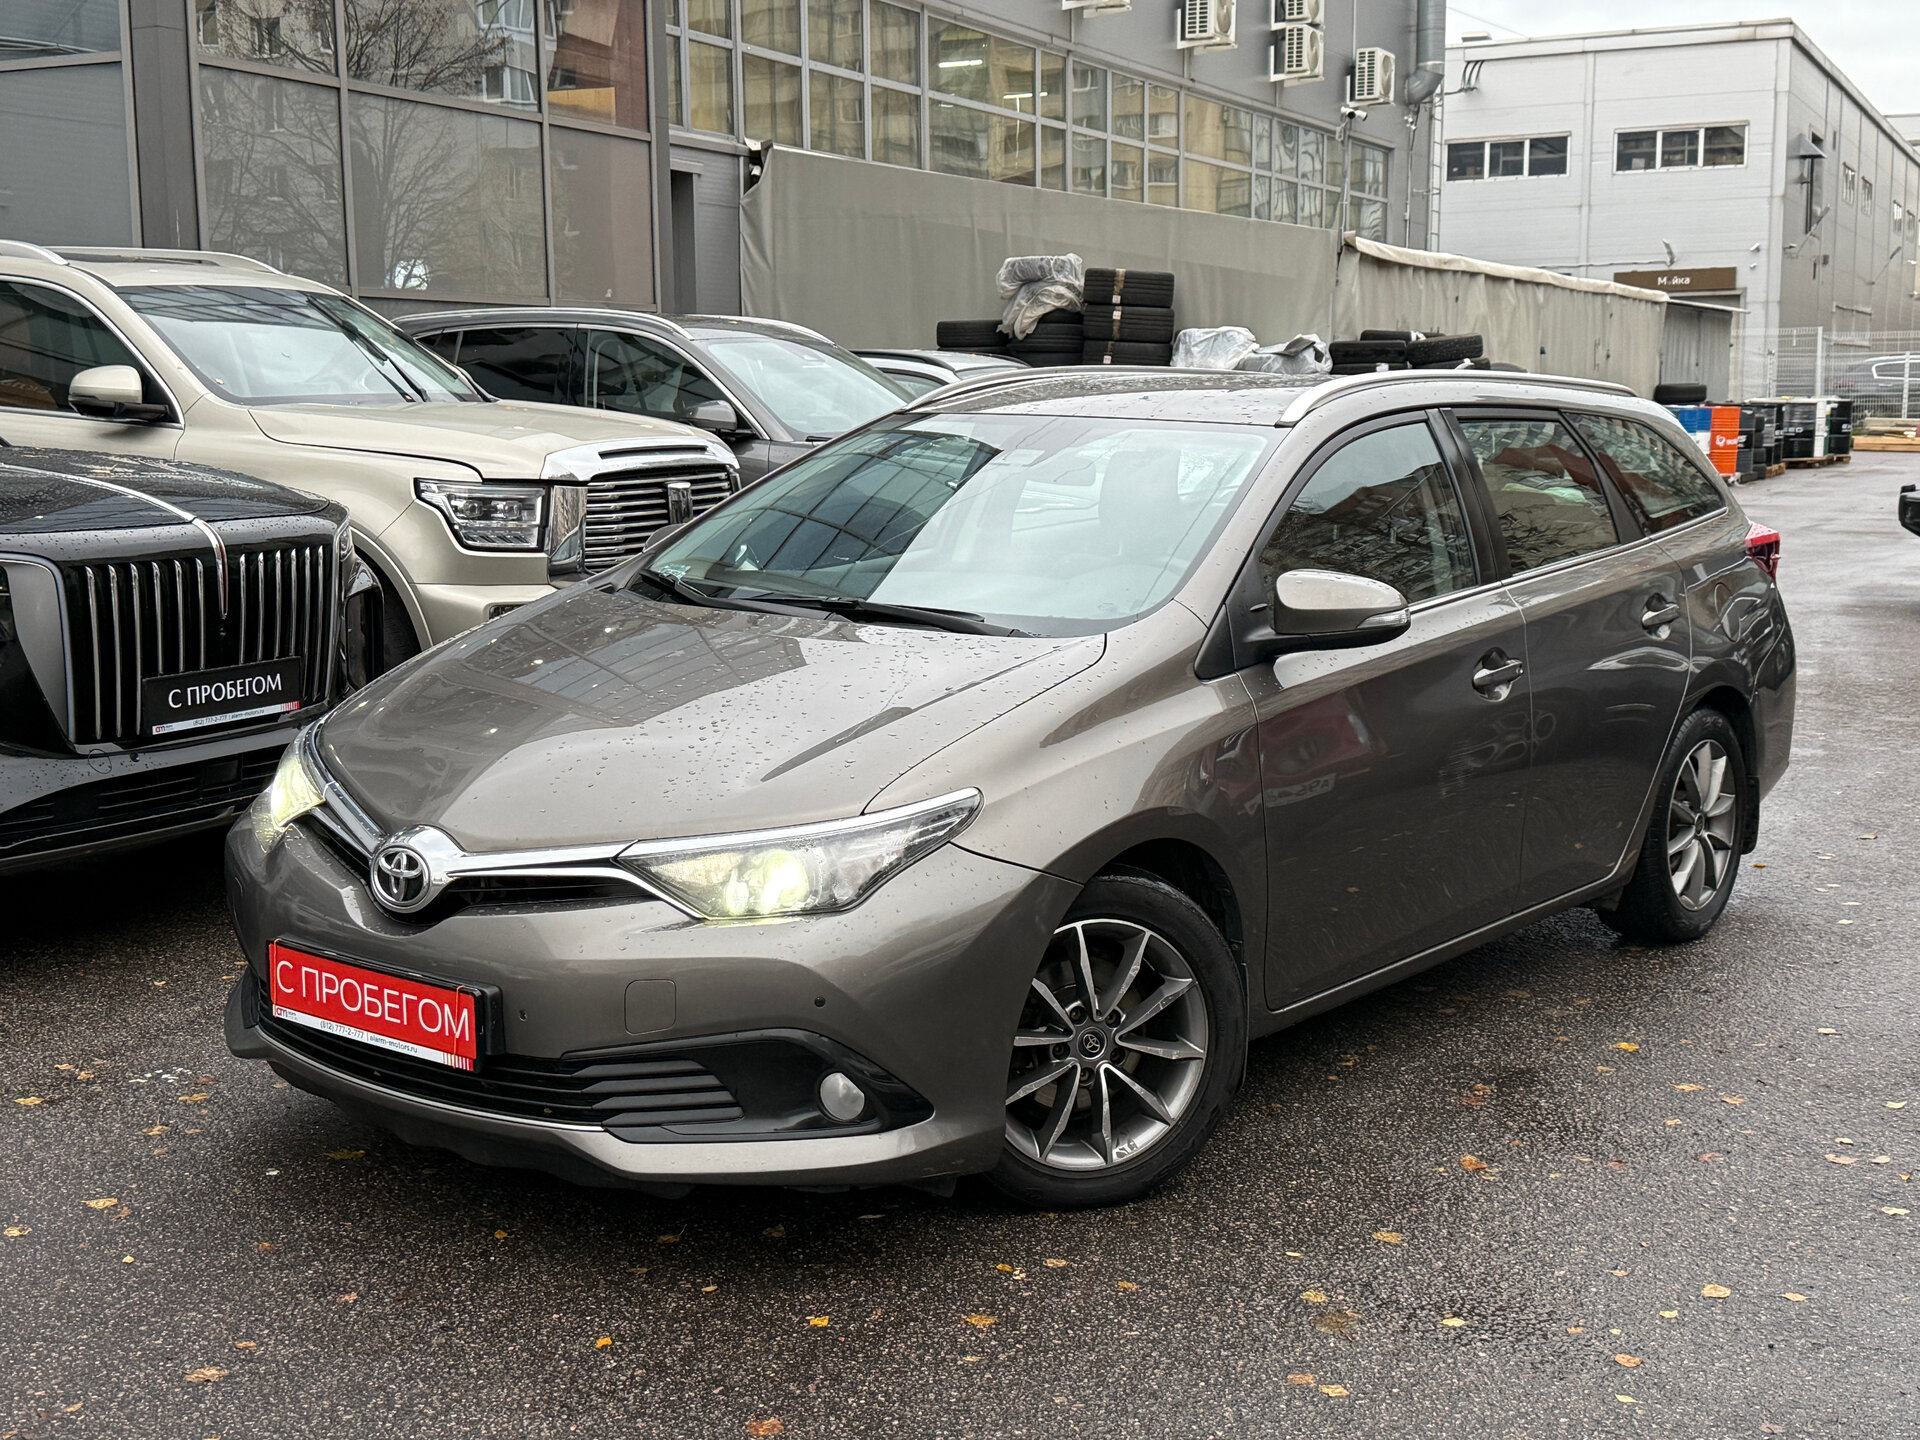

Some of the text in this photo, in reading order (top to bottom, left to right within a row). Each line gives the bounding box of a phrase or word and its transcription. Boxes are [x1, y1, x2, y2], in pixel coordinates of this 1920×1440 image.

[1657, 275, 1690, 286] Мйка
[168, 674, 282, 709] С ПРОБЕГОМ
[276, 960, 470, 1042] С ПРОБЕГОМ
[335, 1025, 364, 1039] 777-2-777
[369, 1035, 418, 1054] alarm-motors.ru
